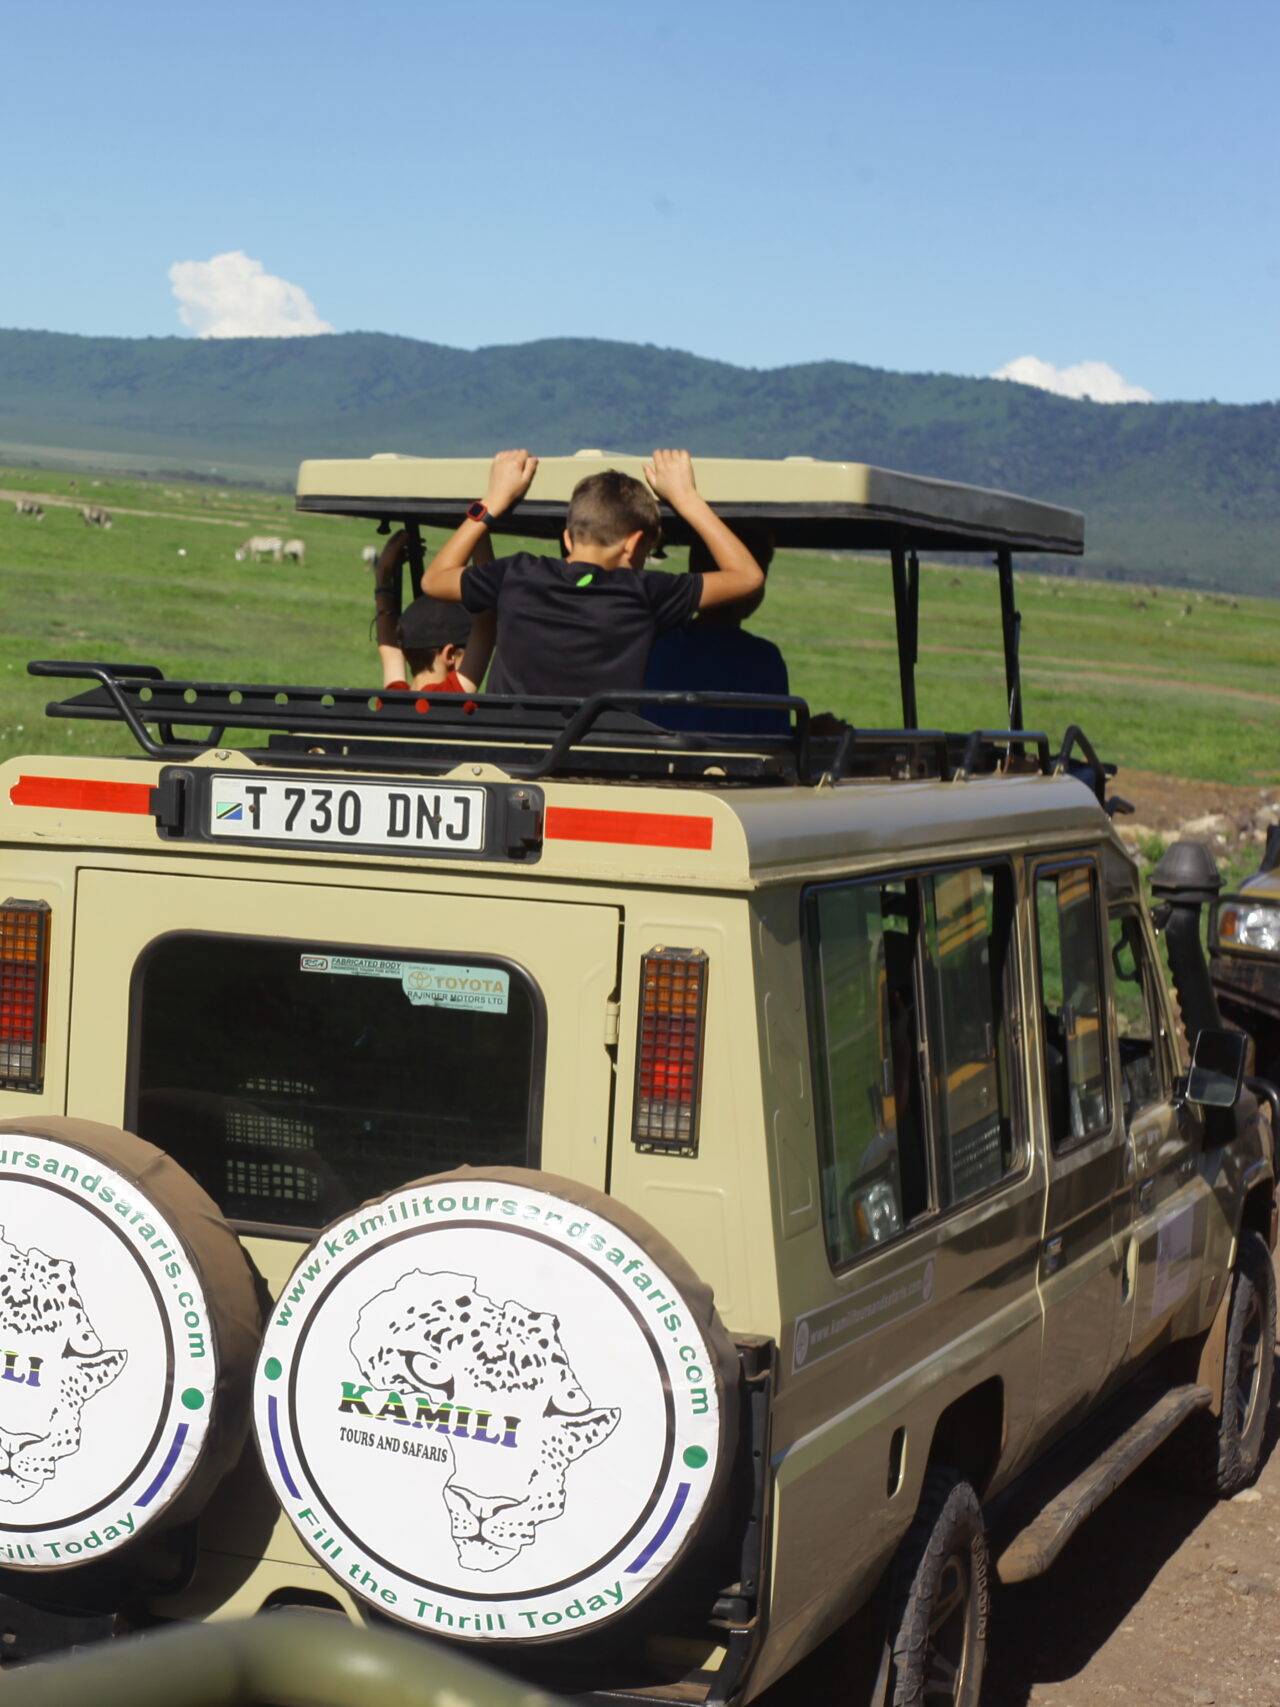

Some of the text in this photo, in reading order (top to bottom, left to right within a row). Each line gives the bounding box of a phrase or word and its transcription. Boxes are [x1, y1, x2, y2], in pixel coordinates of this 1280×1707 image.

[245, 785, 470, 841] T 730 DNJ
[331, 957, 401, 970] FABRICATED BODY
[434, 975, 505, 993] TOYOTA
[407, 990, 448, 1001] RAJINDER
[450, 994, 486, 1004] MOTORS
[276, 1195, 709, 1416] www.kamilitoursandsafaris.com
[337, 1381, 522, 1449] KAMILI
[339, 1426, 448, 1463] TOURS AND SAFARIS
[43, 1512, 139, 1559] Today
[297, 1507, 625, 1631] Fill the Thrill Today
